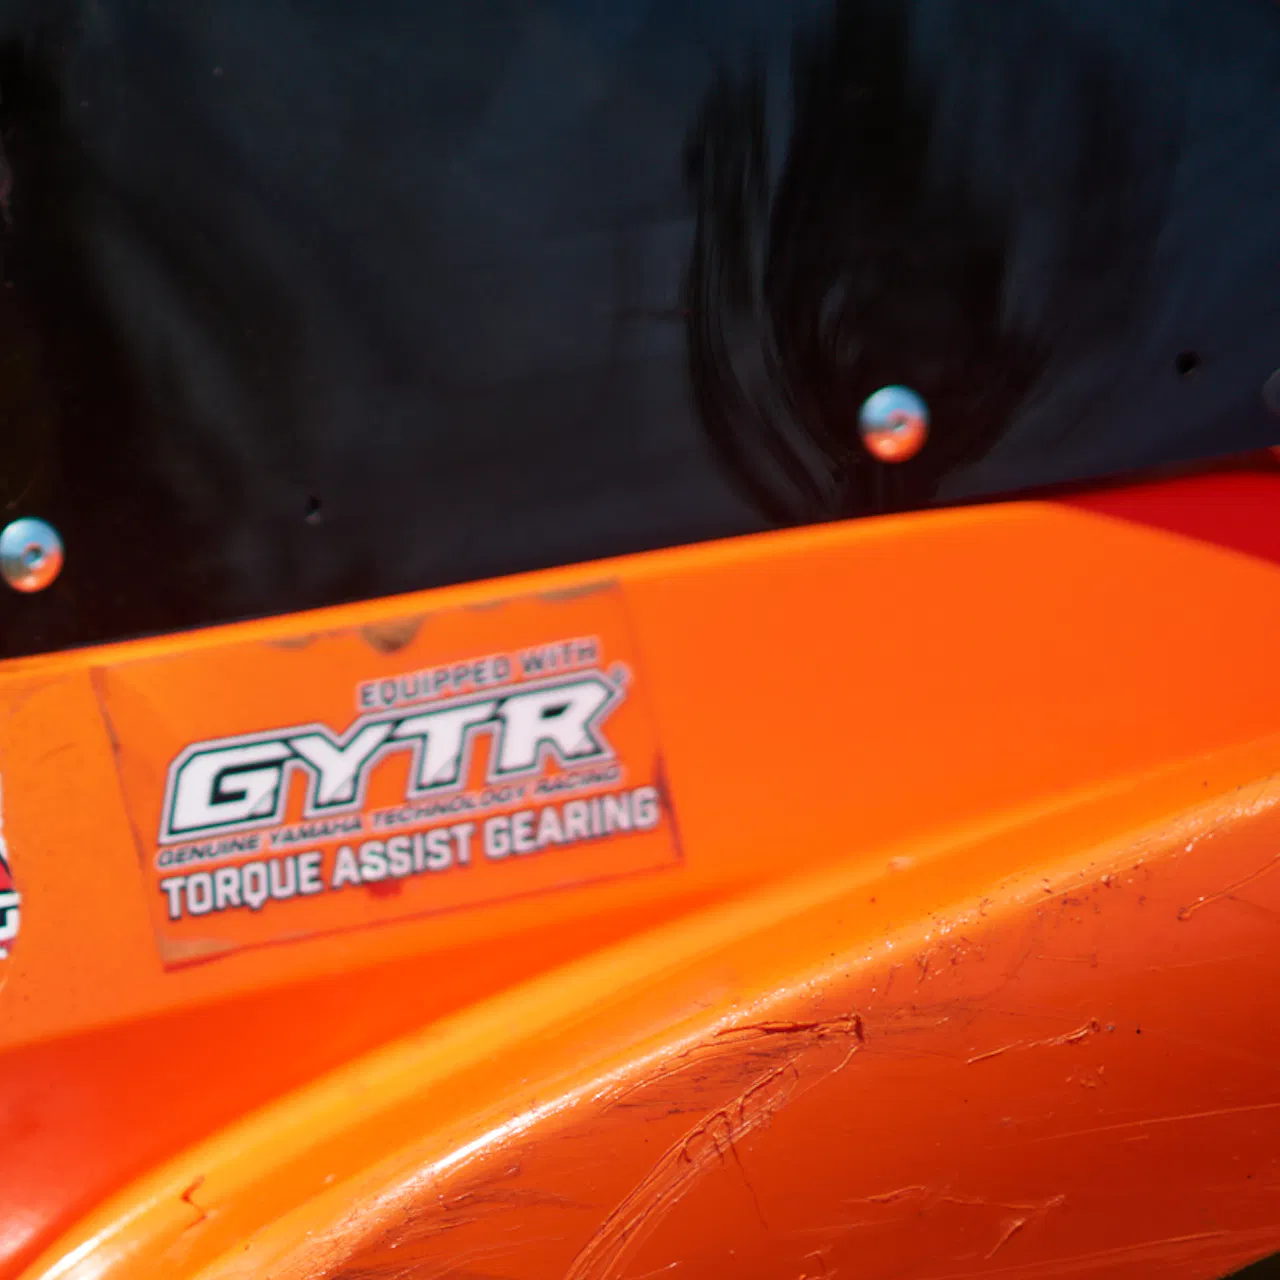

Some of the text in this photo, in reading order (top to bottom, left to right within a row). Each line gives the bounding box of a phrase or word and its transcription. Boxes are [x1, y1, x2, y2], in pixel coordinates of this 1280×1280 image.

[359, 640, 598, 704] EQUIPPED WITH
[160, 670, 621, 843] GYTR
[157, 834, 260, 867] GENUINE
[269, 811, 363, 843] YAMAHA
[160, 785, 660, 920] TORQUE ASSIST GEARING
